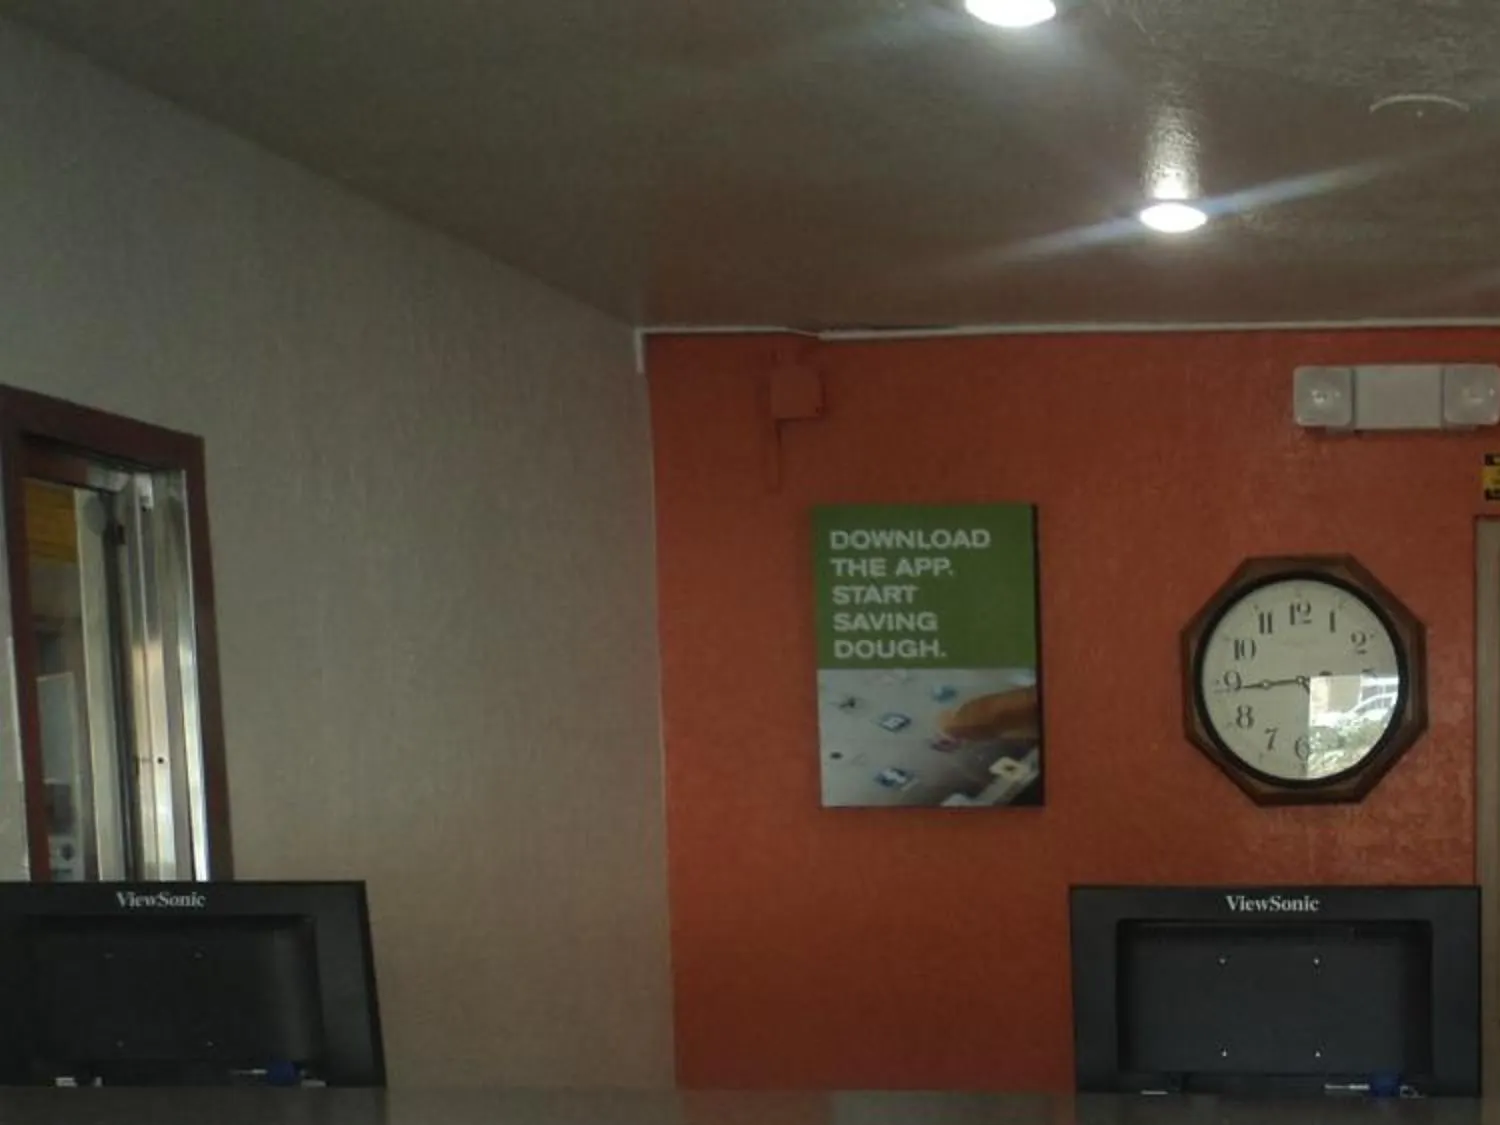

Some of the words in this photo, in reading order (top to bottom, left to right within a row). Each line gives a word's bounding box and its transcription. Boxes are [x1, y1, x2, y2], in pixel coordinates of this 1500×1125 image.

[830, 529, 990, 549] DOWNLOAD
[831, 557, 886, 577] THE
[896, 557, 953, 577] APP.
[832, 585, 919, 605] START
[834, 612, 938, 632] SAVING
[1258, 612, 1273, 634] 11
[1289, 601, 1312, 626] 12
[1329, 611, 1336, 633] 1
[834, 640, 946, 660] DOUGH.
[1234, 640, 1256, 661] 10
[1350, 631, 1367, 655] 2
[1223, 671, 1241, 692] 9
[1236, 705, 1254, 729] 8
[1264, 728, 1278, 751] 7
[116, 891, 206, 908] ViewSonic
[1225, 894, 1320, 912] ViewSonic
